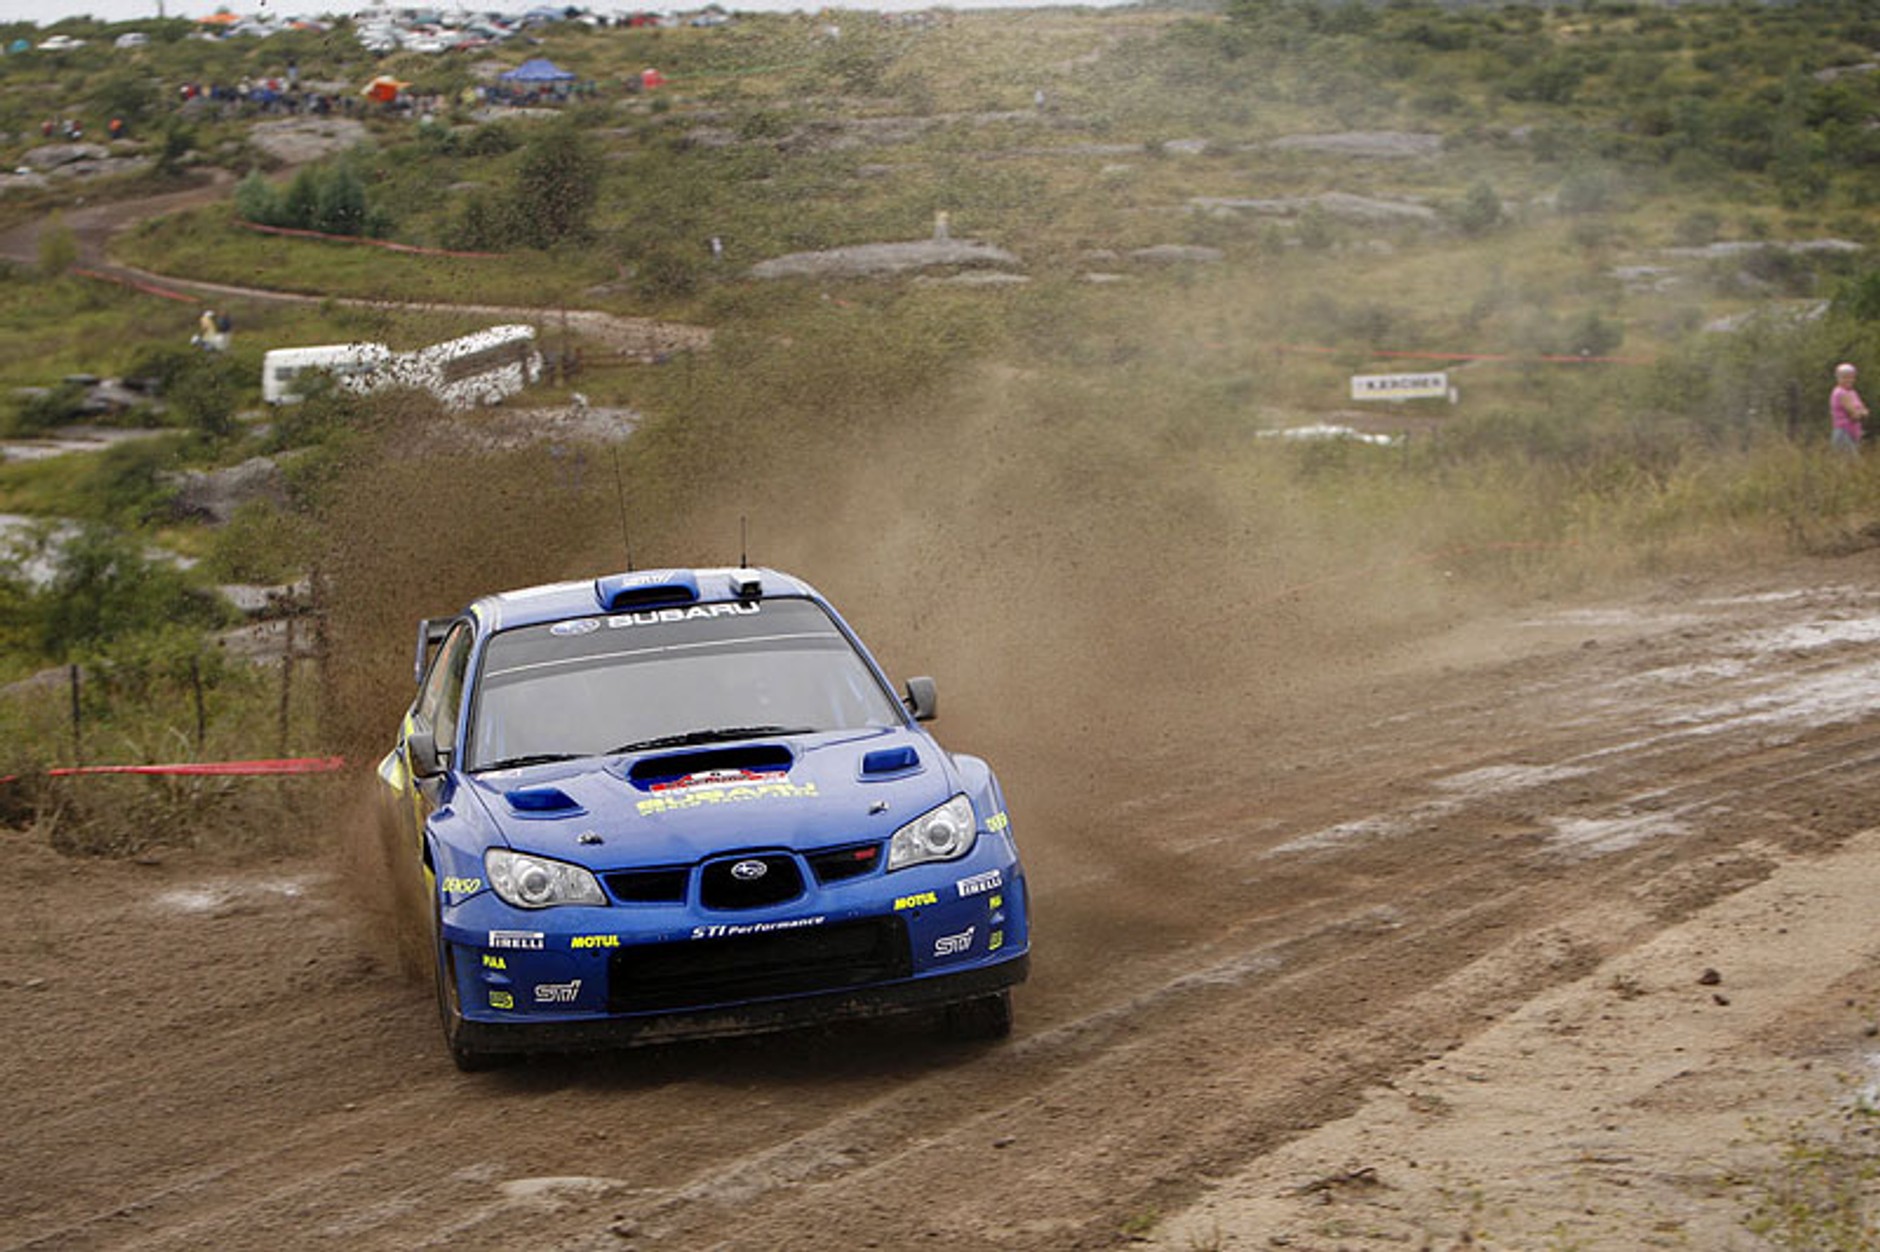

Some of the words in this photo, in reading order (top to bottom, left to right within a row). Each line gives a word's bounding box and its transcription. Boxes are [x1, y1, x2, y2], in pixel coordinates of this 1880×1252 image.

[608, 602, 760, 628] SUBARU
[956, 869, 1003, 897] PIRELLI
[893, 891, 938, 911] MOTUL
[488, 930, 544, 948] PIRELLI
[691, 925, 726, 940] STI
[728, 916, 825, 936] Performance
[571, 935, 621, 949] MOTUL
